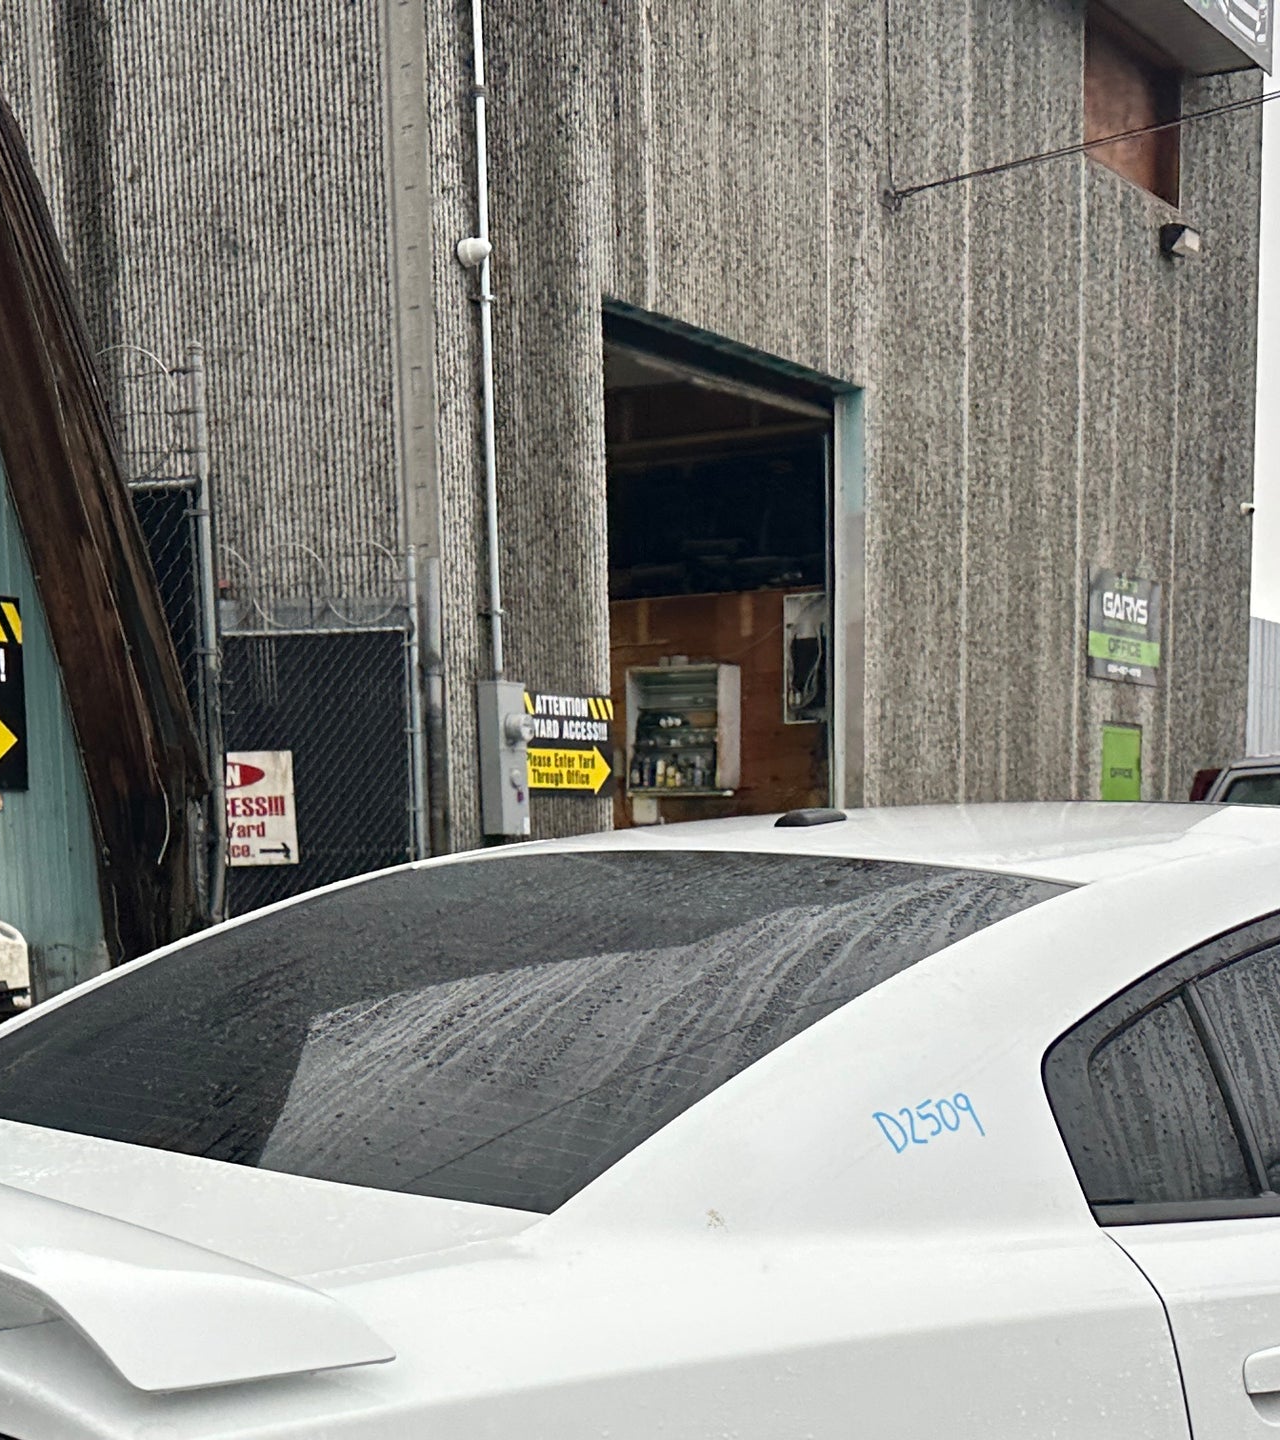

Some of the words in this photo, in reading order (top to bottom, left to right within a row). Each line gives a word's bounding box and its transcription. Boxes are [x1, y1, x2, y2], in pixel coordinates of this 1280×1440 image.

[535, 694, 588, 717] ATTENTION
[533, 719, 560, 738] YARD
[562, 720, 608, 741] ACCESS!!!
[554, 752, 576, 769] Enter
[578, 753, 596, 770] Yard
[532, 768, 564, 786] Through
[566, 769, 590, 786] Office
[872, 1092, 986, 1153] D2509
